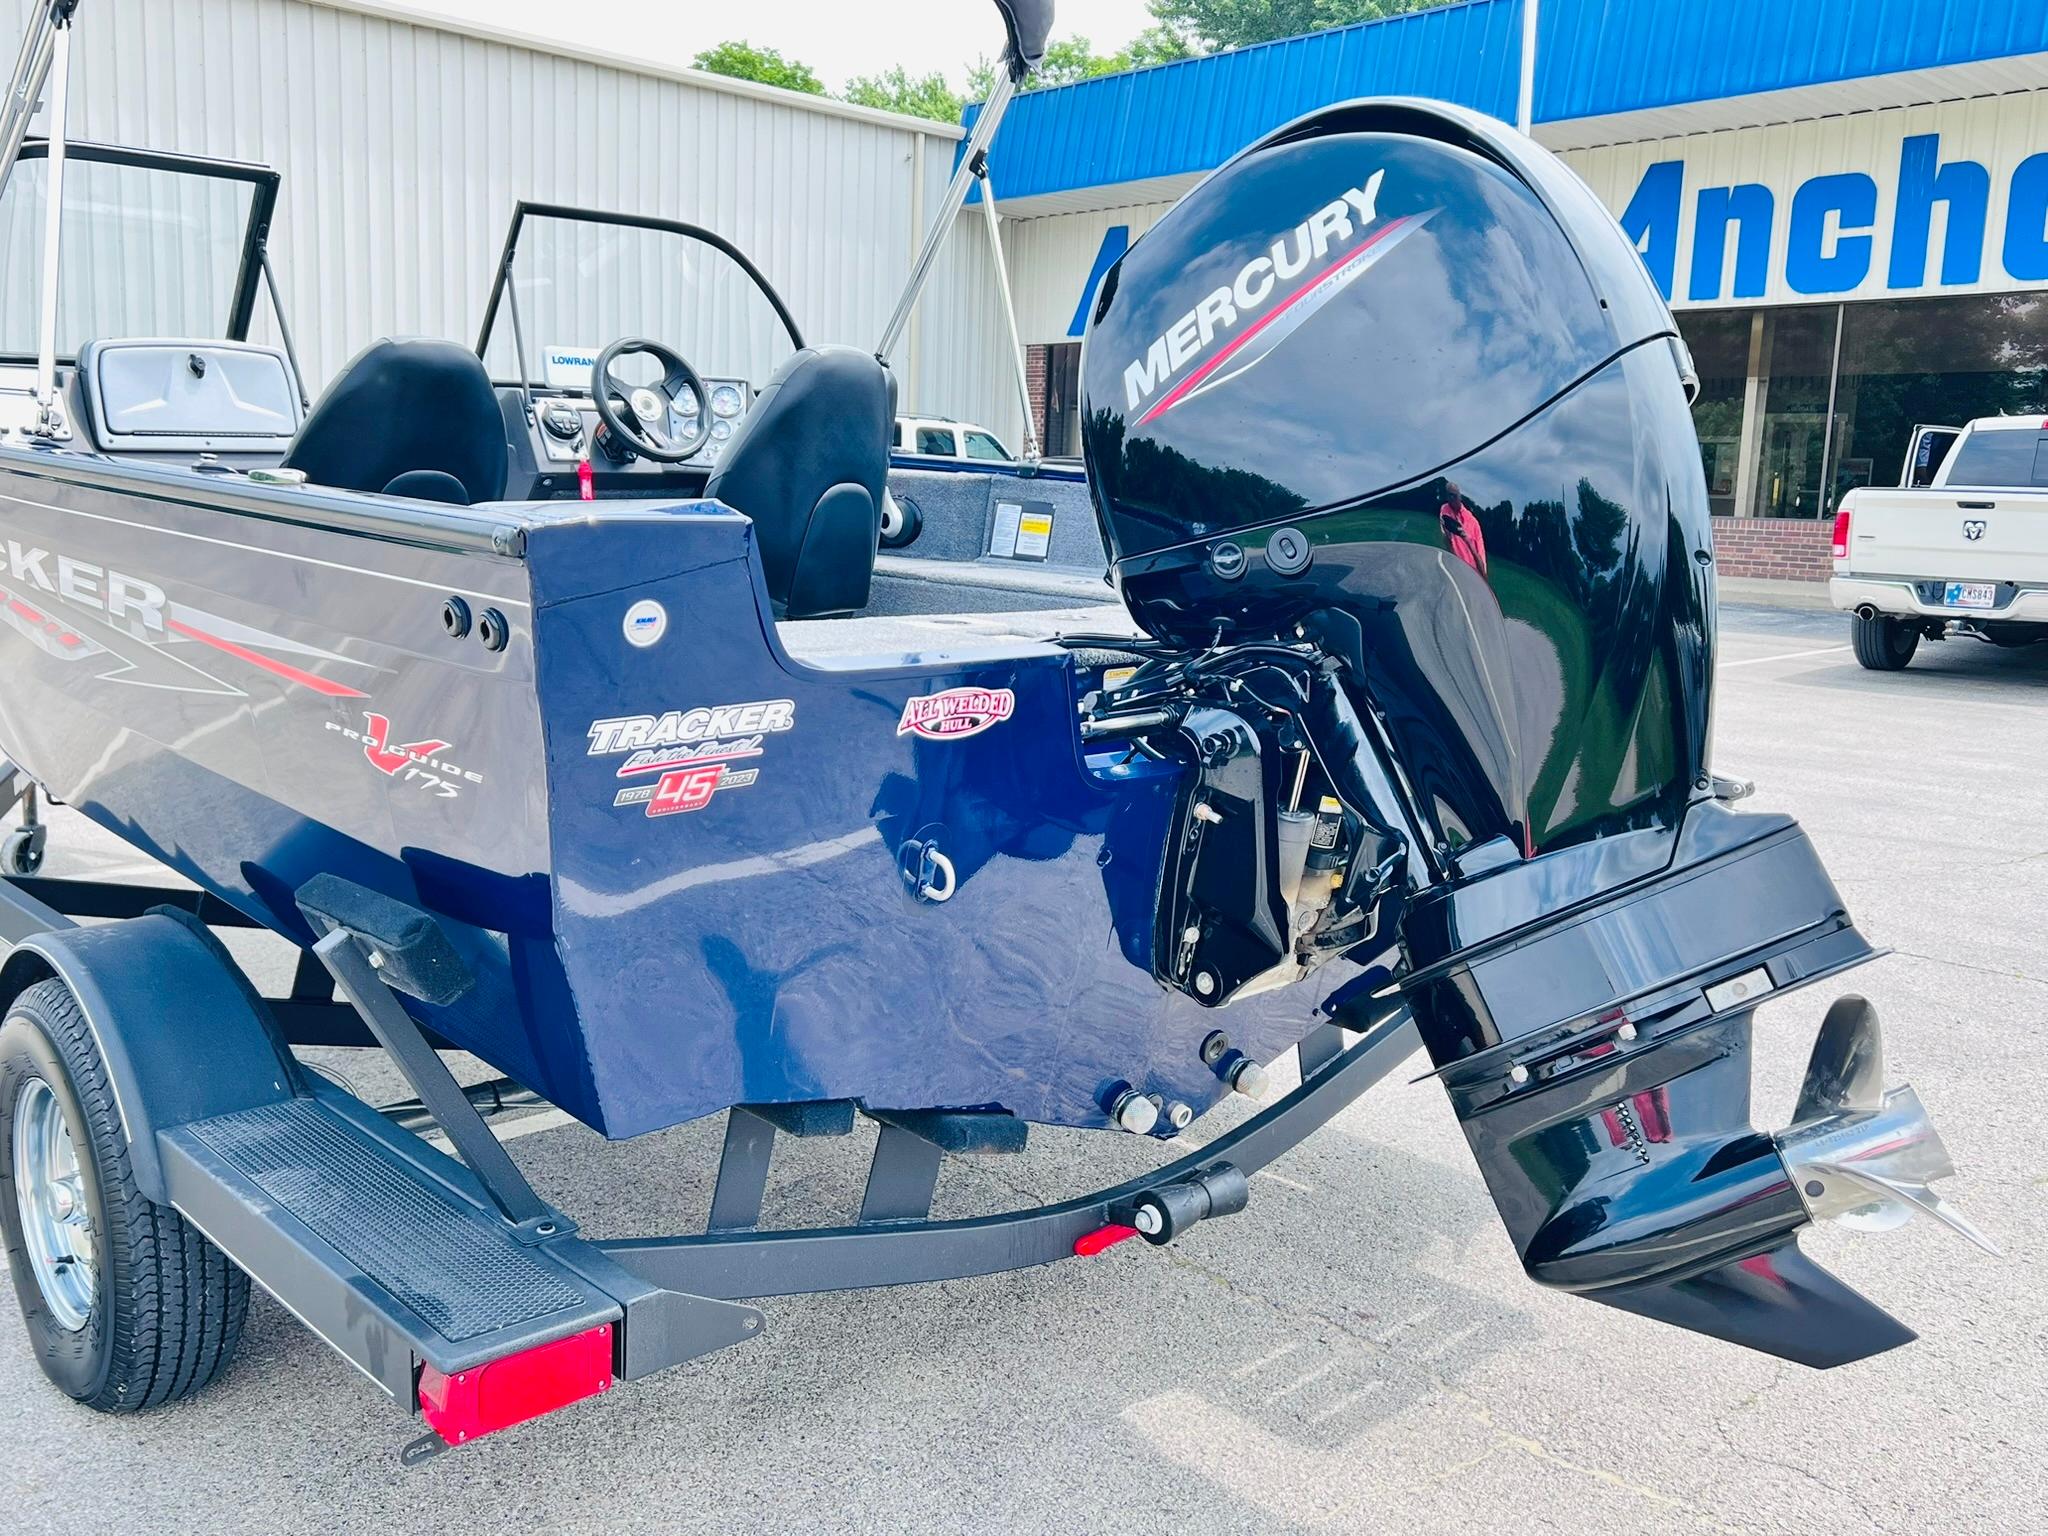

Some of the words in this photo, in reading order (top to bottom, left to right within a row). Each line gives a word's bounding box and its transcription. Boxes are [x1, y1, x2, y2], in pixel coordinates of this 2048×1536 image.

[1123, 168, 1385, 412] MERCURY
[0, 539, 167, 632] KER
[589, 700, 793, 754] TRACKER
[902, 700, 940, 730] ALL
[941, 692, 1012, 717] WELDED
[940, 718, 973, 732] HULL
[325, 721, 378, 747] PRO
[388, 745, 484, 783] GUIDE
[404, 768, 463, 798] 175
[620, 789, 651, 802] 1978
[656, 771, 717, 803] 45
[720, 772, 754, 786] 2023
